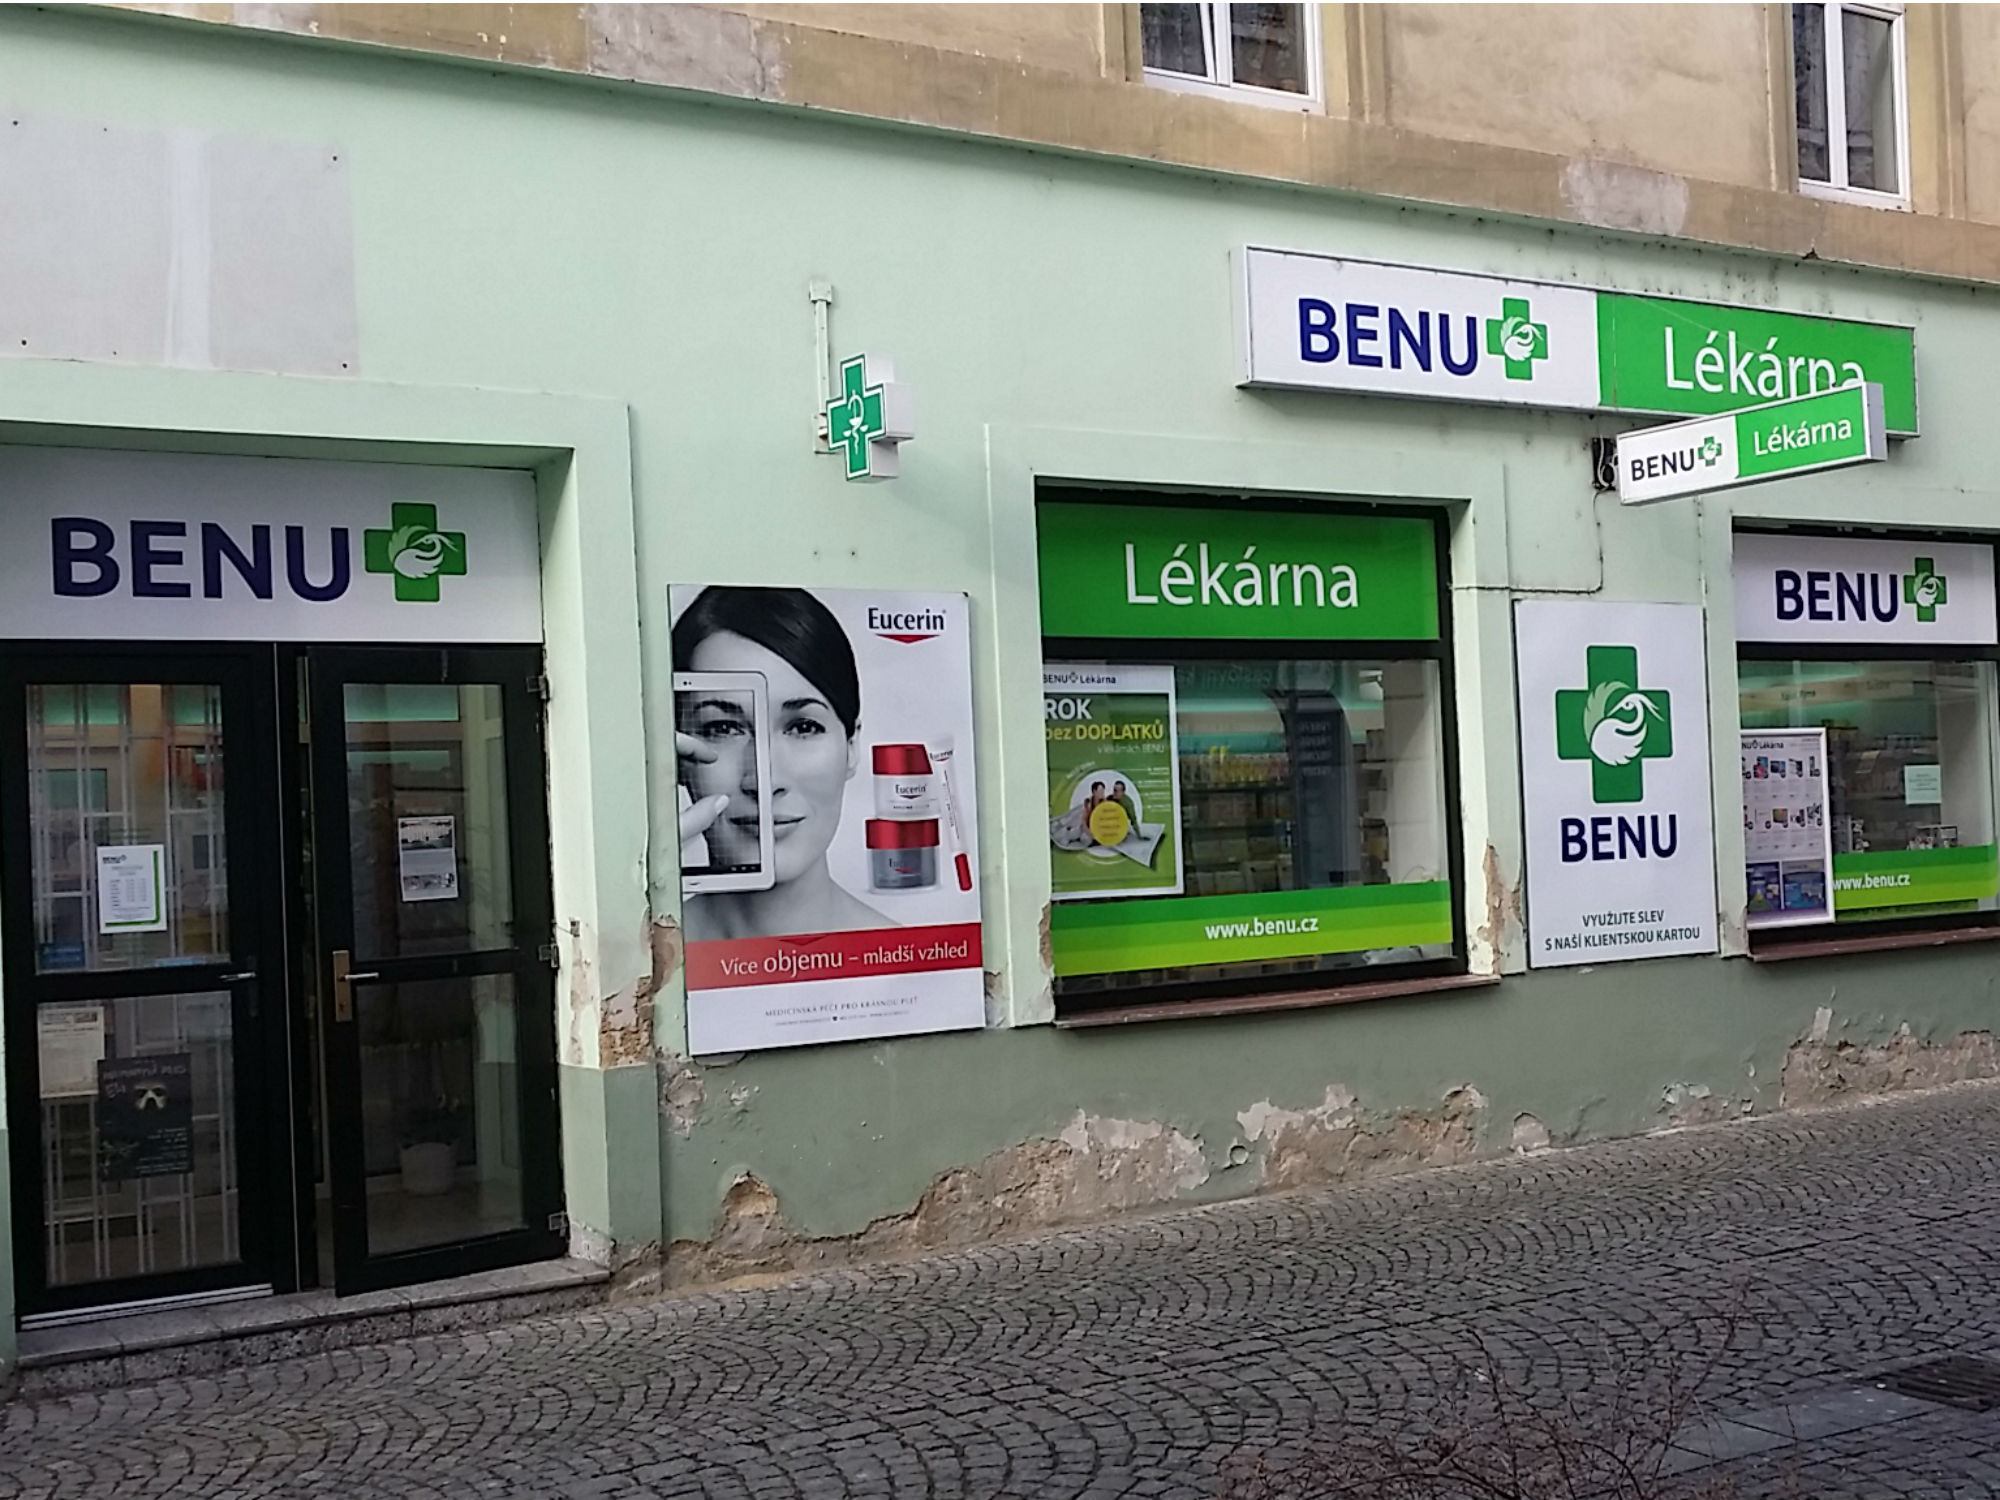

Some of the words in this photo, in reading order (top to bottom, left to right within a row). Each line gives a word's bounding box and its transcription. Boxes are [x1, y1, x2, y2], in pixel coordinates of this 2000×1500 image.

[1298, 298, 1478, 376] BENU
[1664, 326, 1866, 400] Lékárna
[1631, 448, 1695, 482] BENU
[1753, 418, 1852, 456] Lékárna
[50, 516, 351, 602] BENU
[1124, 542, 1359, 608] Lékárna
[1774, 569, 1899, 623] BENU
[868, 607, 944, 630] Eucerin
[1044, 698, 1092, 720] ROK
[1075, 719, 1164, 740] DOPLATKŮ
[1559, 813, 1678, 864] BENU
[1204, 915, 1319, 941] www.benu.cz
[1582, 911, 1636, 927] VYUŽIJTE
[1638, 910, 1665, 924] SLEV
[1545, 938, 1552, 951] S
[1554, 933, 1582, 950] NAŠÍ
[1584, 930, 1654, 948] KLIENTSKOU
[1656, 926, 1701, 942] KARTOU
[720, 958, 758, 976] Více
[763, 949, 843, 978] objemu
[863, 944, 914, 965] mladší
[917, 940, 968, 961] vzhled
[841, 1002, 858, 1011] PRO
